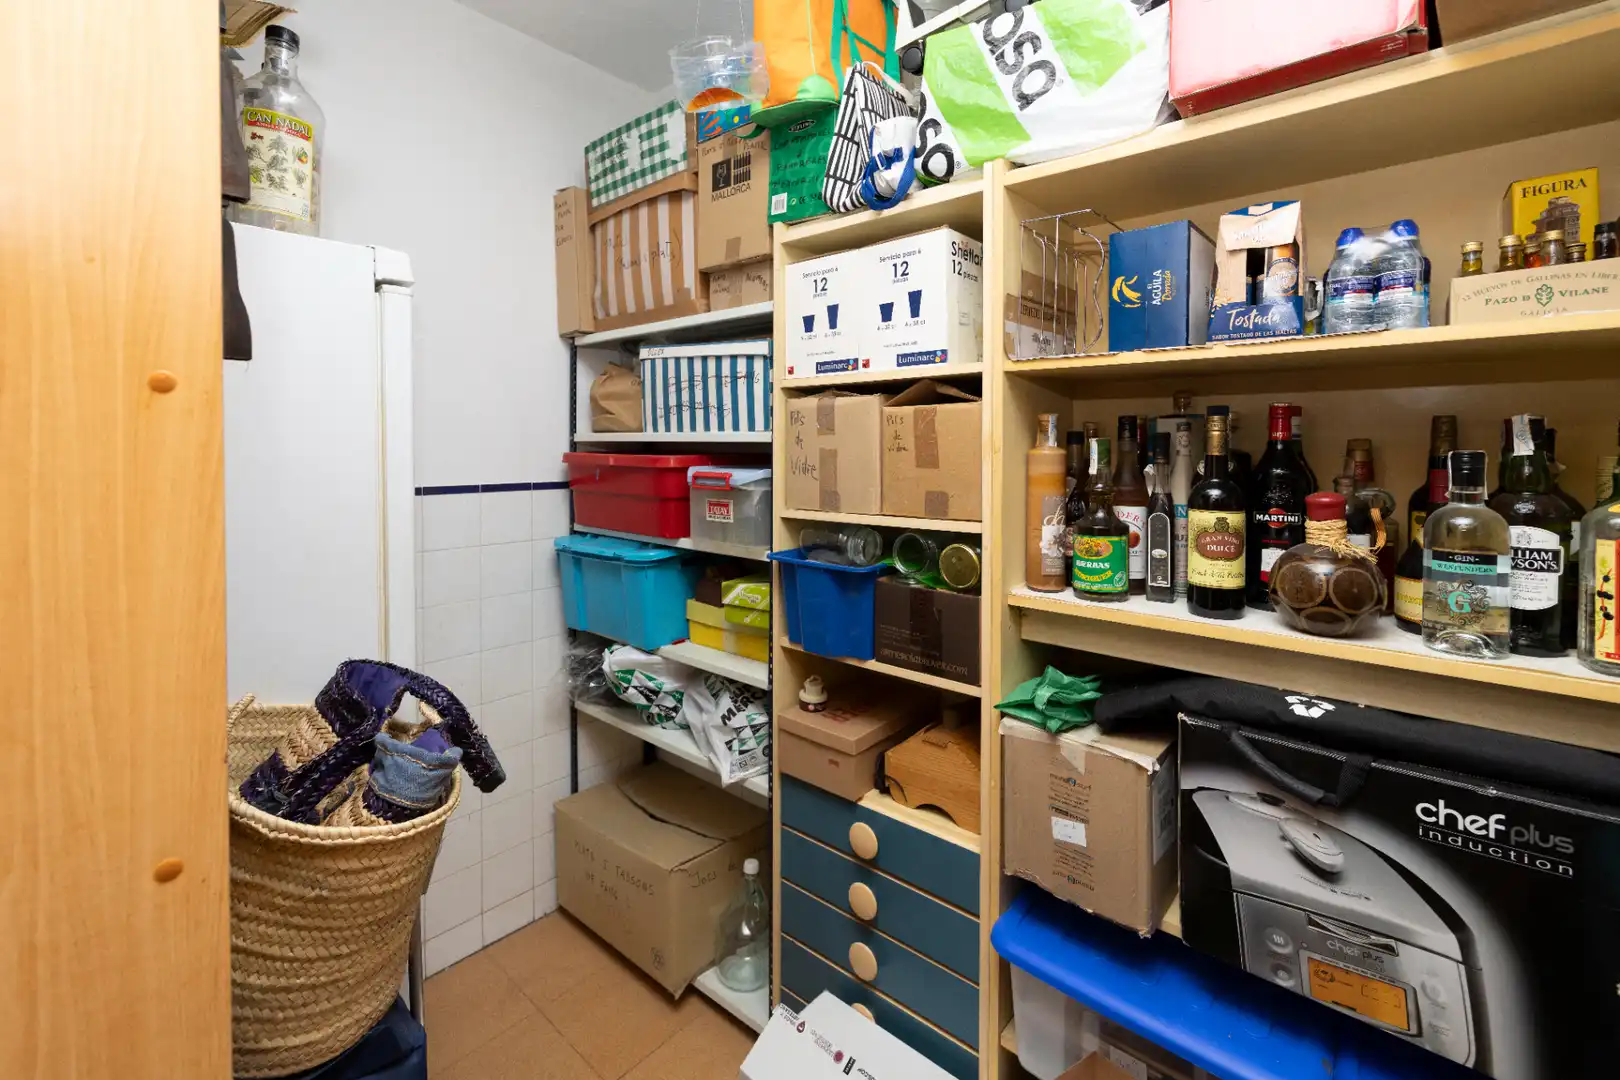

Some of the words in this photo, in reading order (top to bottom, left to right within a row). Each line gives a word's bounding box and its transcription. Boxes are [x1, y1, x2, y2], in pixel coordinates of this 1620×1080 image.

[247, 110, 273, 125] CAN
[275, 115, 312, 138] NADAL
[711, 182, 751, 203] MALLORCA
[1521, 177, 1588, 199] FIGURA
[892, 260, 910, 279] 12
[952, 259, 963, 277] 12
[1591, 269, 1620, 280] LIBER
[812, 276, 828, 294] 12
[1162, 269, 1172, 303] Dorada
[1484, 295, 1518, 306] PAZO
[1557, 287, 1609, 298] VILANE
[1226, 307, 1280, 331] Tostada
[1211, 333, 1229, 341] SABOR
[1229, 331, 1254, 339] TOSTADO
[816, 361, 848, 373] Luminarc
[898, 353, 935, 365] Luminarc
[1255, 513, 1299, 523] MARTINI
[1201, 535, 1222, 544] GRAN
[1224, 535, 1240, 545] VINO
[1207, 544, 1236, 553] DULCE
[1454, 554, 1475, 562] GIN
[1511, 549, 1553, 561] LLIAM
[1447, 591, 1472, 613] G
[1415, 799, 1506, 839] chef
[1510, 823, 1575, 854] plus
[1418, 825, 1574, 877] induction
[1326, 939, 1360, 957] chef
